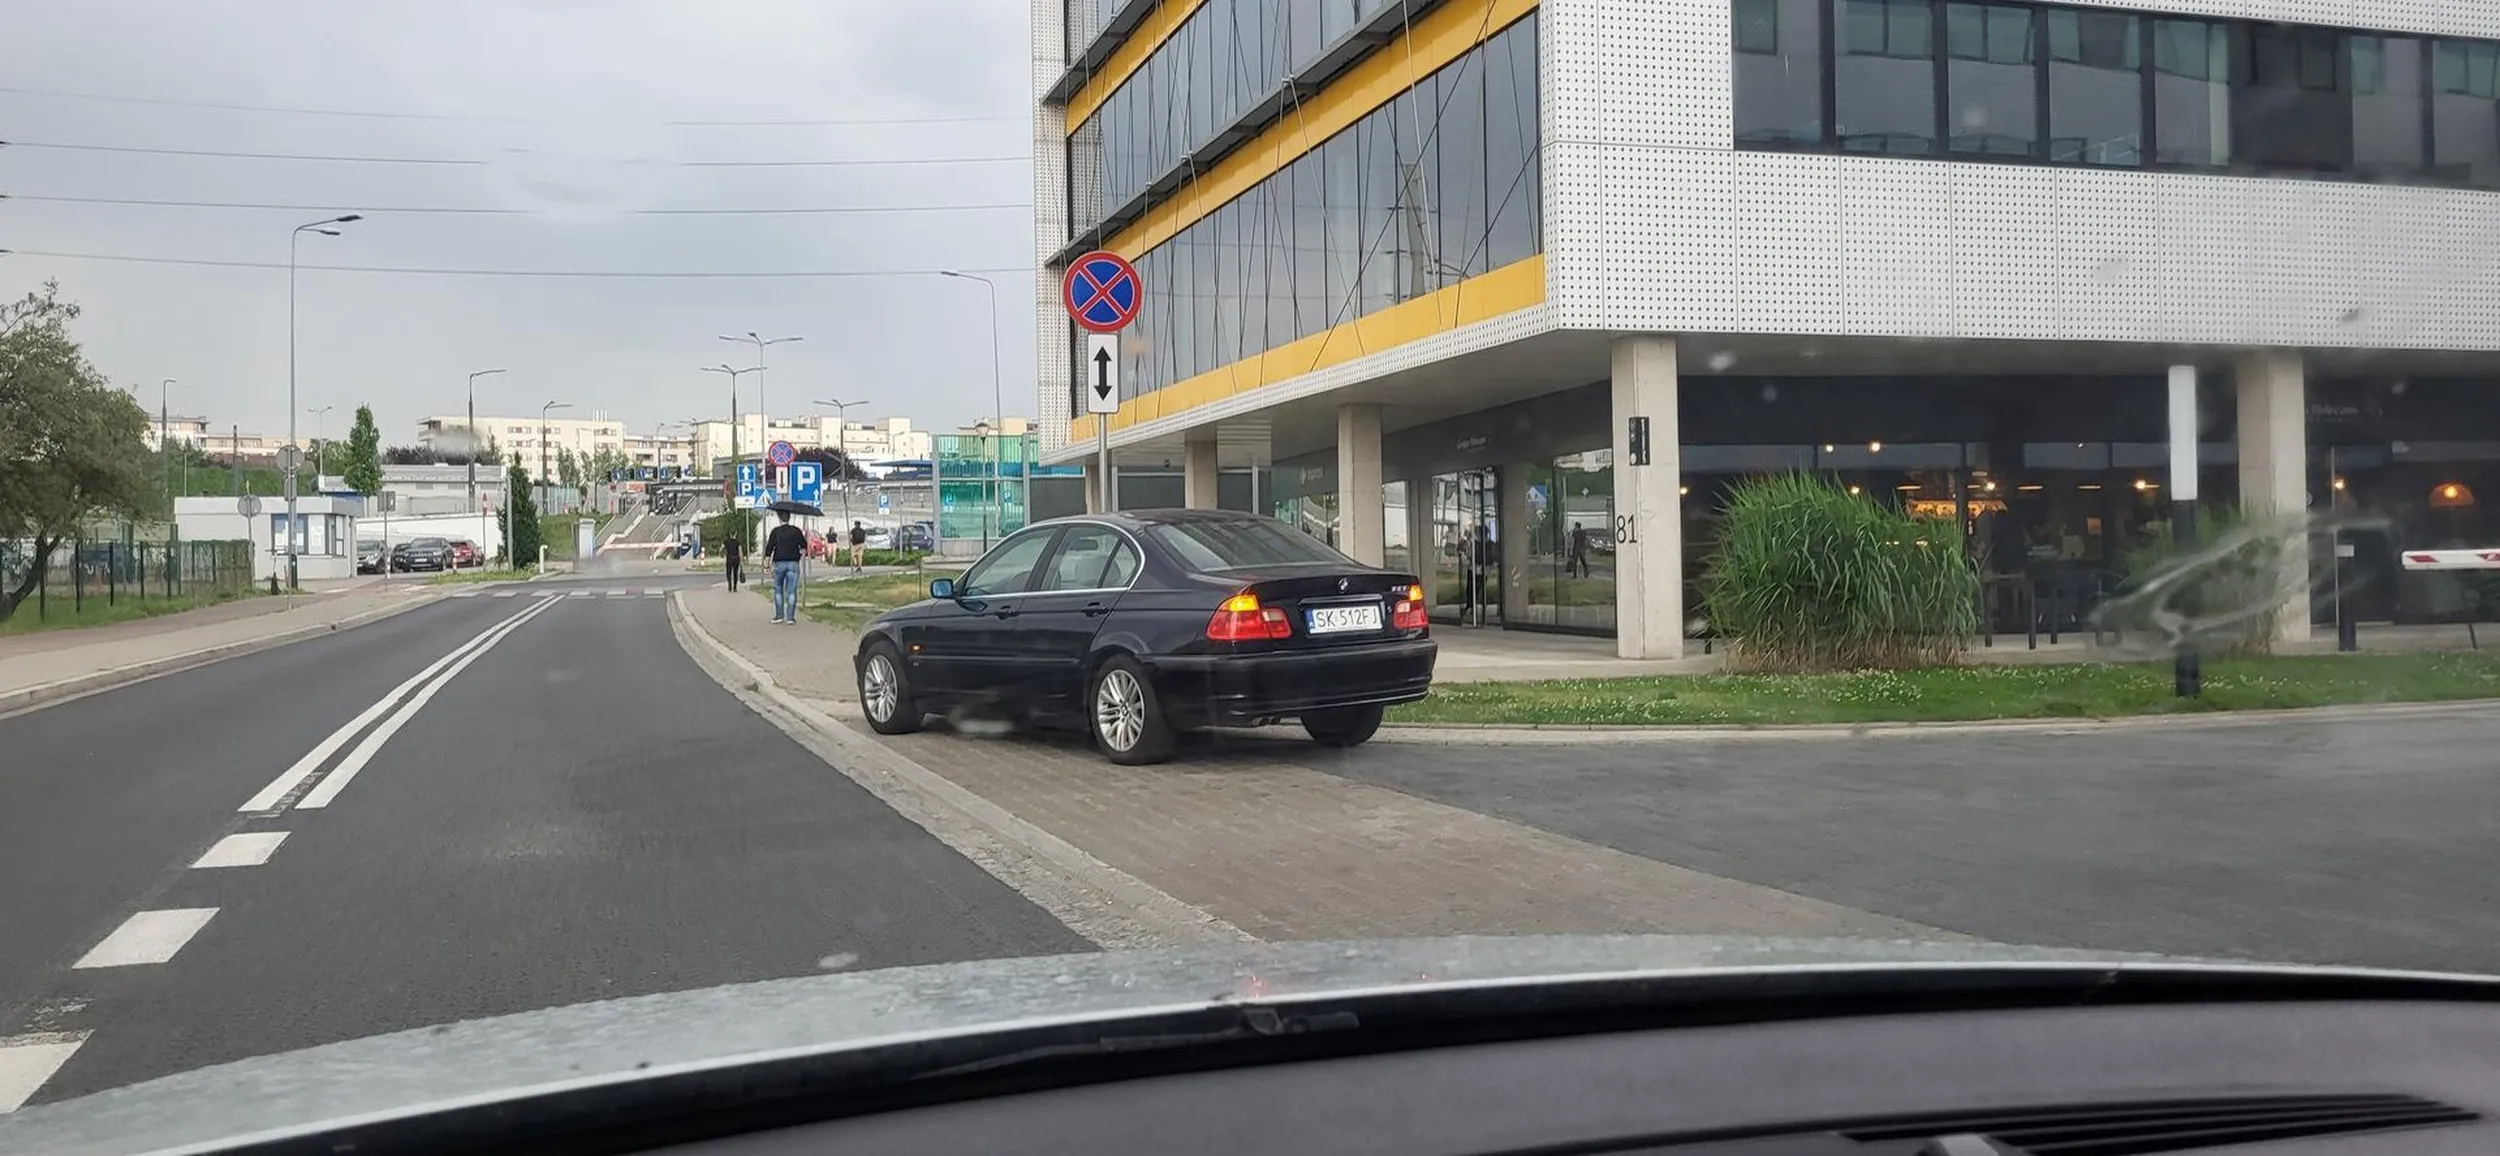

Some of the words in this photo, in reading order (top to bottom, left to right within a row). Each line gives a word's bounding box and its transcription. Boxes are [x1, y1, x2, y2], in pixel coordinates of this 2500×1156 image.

[741, 482, 752, 496] P
[797, 466, 816, 492] P
[880, 495, 888, 507] P
[1617, 513, 1638, 544] 81
[1316, 611, 1336, 629] SK
[1340, 608, 1377, 628] 512FJ
